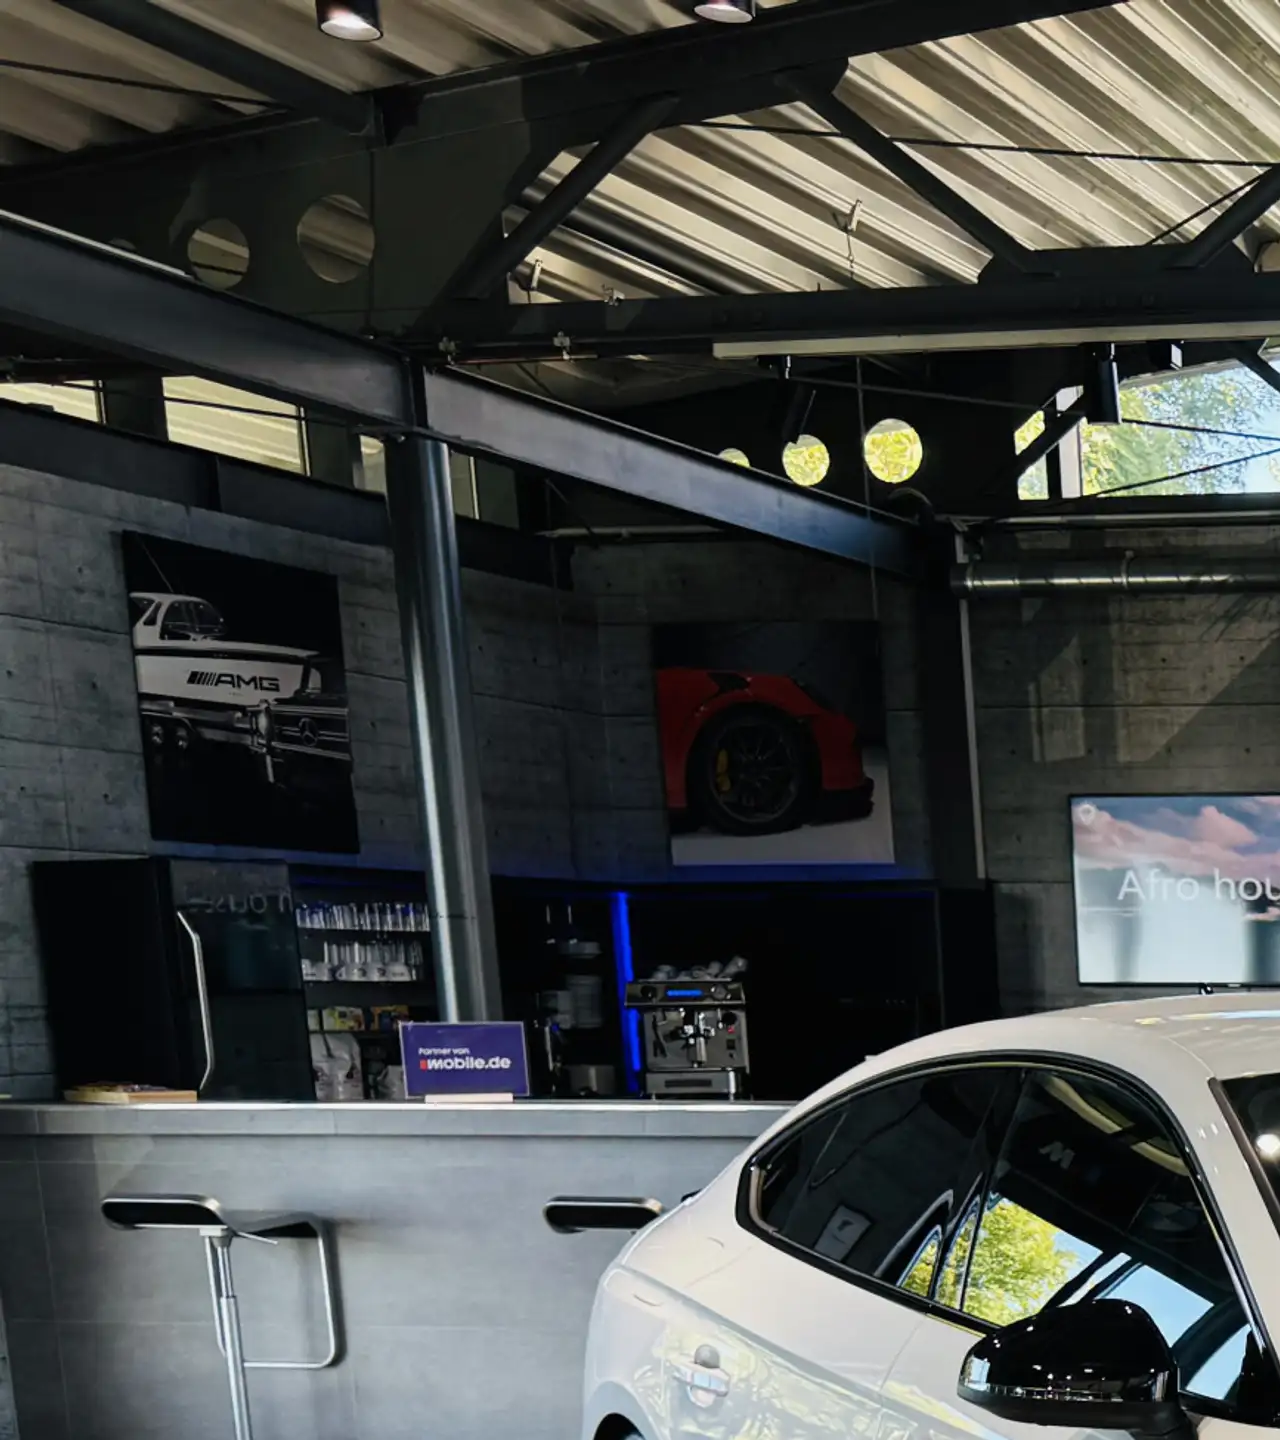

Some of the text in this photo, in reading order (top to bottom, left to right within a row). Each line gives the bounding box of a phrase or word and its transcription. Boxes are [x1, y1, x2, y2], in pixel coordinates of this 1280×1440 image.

[214, 672, 281, 692] AMG
[1117, 868, 1200, 900] Afro
[427, 1057, 512, 1069] mobile.de
